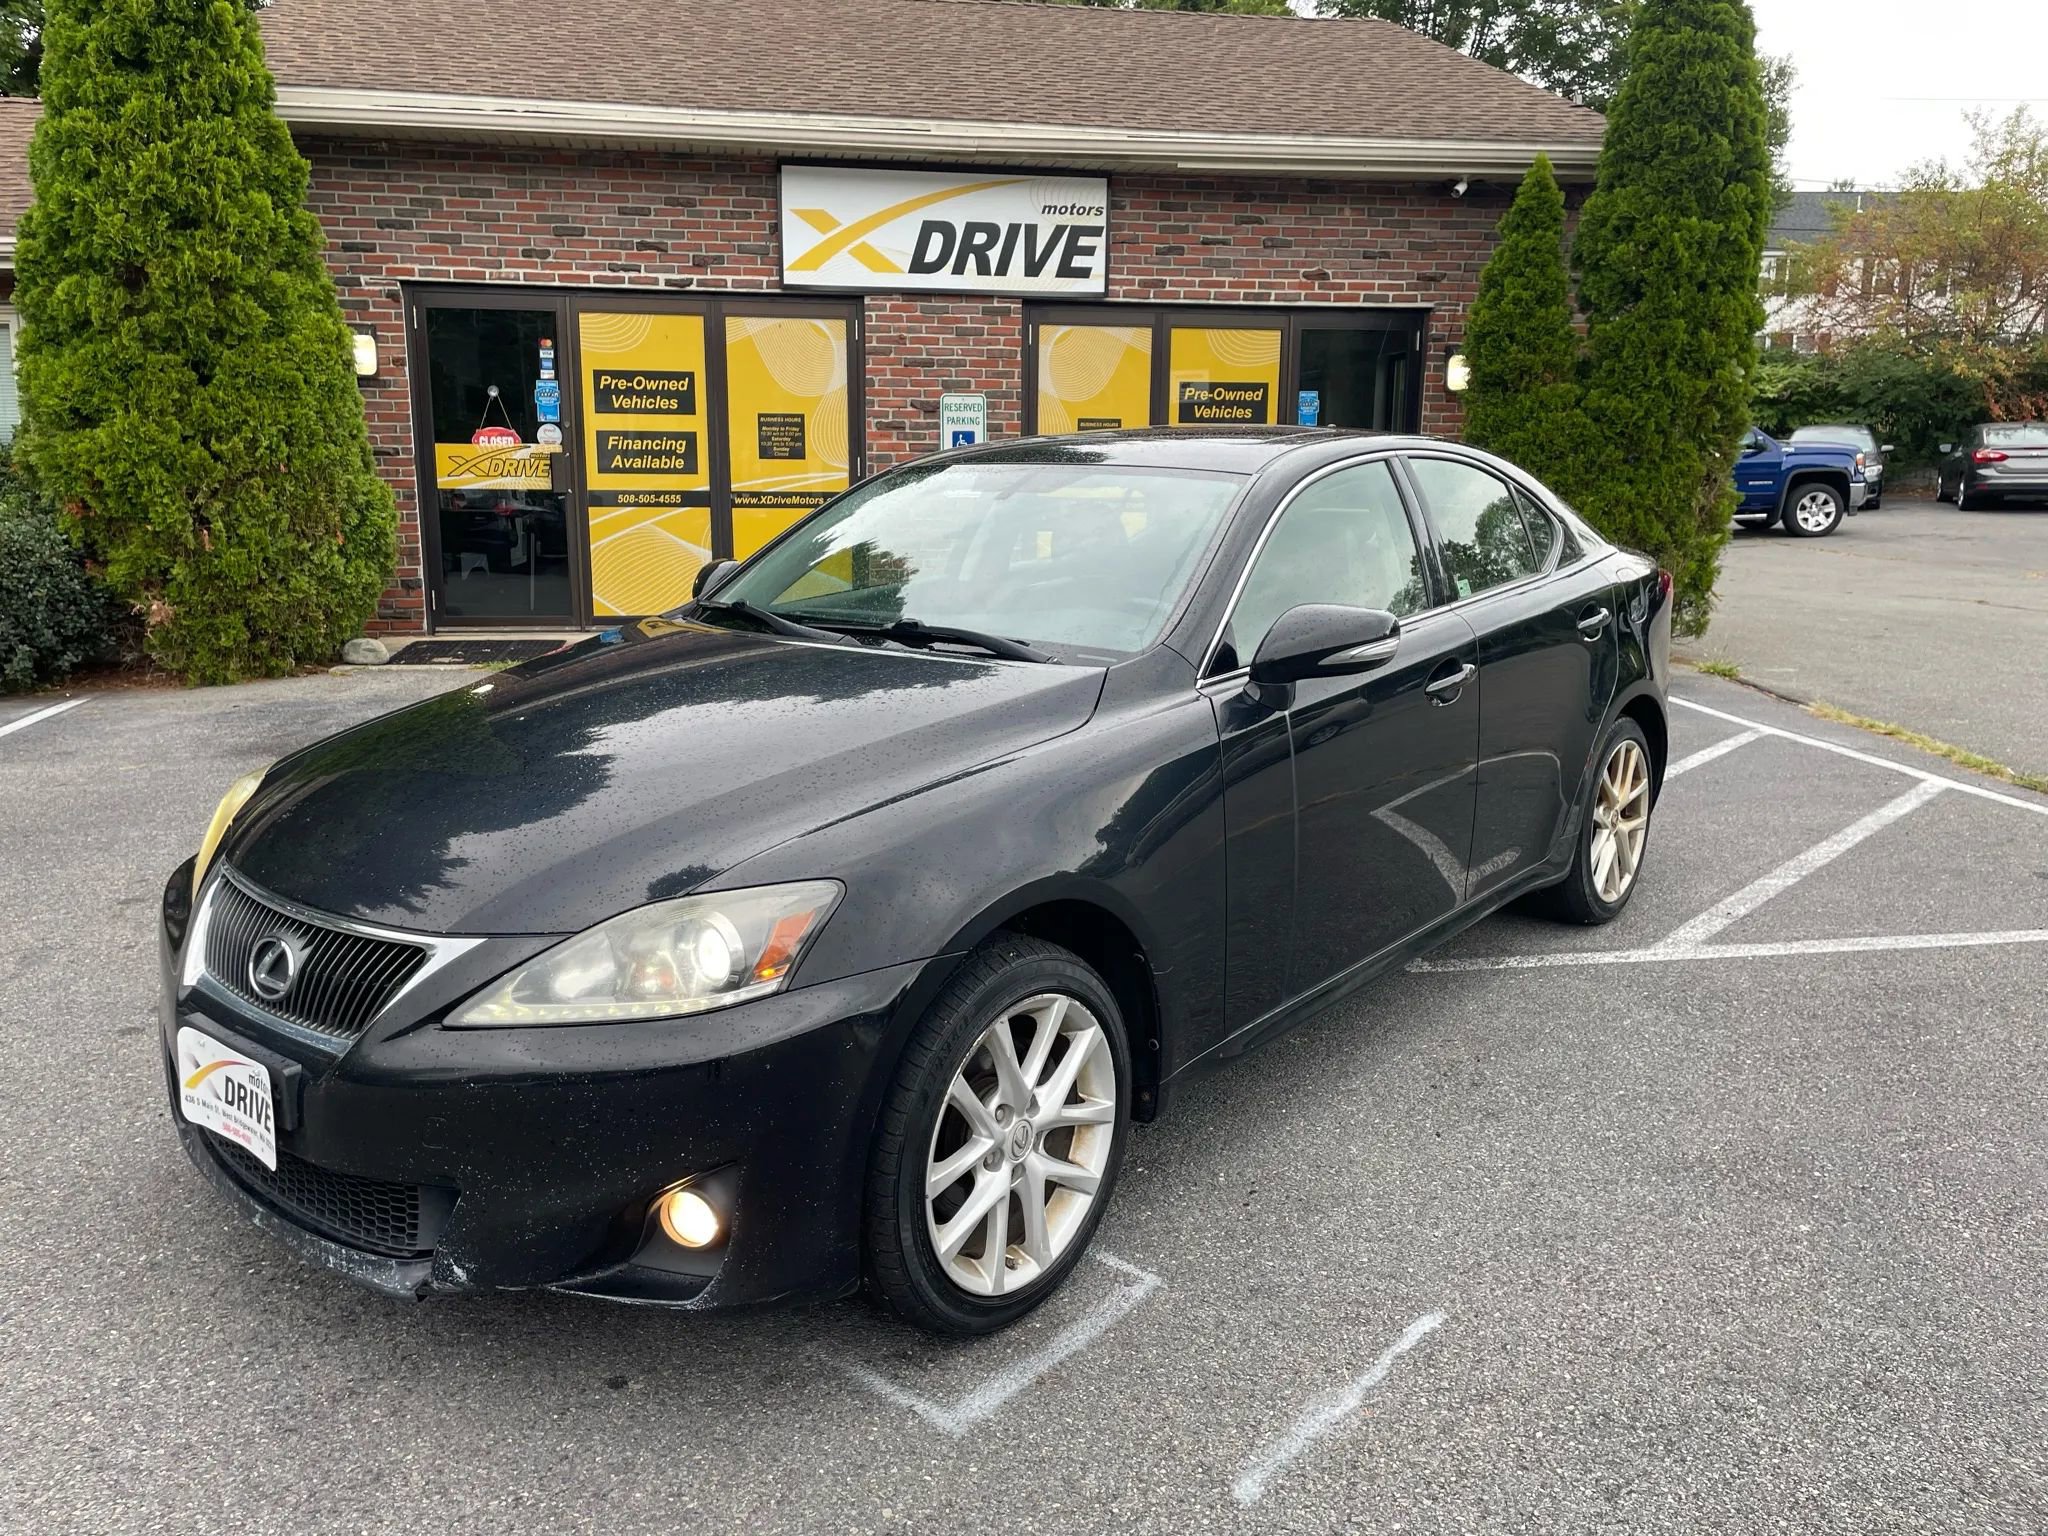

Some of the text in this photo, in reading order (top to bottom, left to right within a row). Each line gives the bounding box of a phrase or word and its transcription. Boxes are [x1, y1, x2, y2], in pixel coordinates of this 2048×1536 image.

[1041, 202, 1104, 217] motors
[908, 220, 1105, 279] DRIVE
[600, 375, 689, 391] Pre-Owned
[1184, 387, 1264, 401] Pre-Owned
[611, 394, 678, 409] Vehicles
[944, 402, 983, 412] RESERVED
[1194, 405, 1253, 419] Vehicles
[947, 417, 980, 426] PARKING
[479, 436, 515, 446] CLOSED
[607, 436, 687, 454] Financing
[611, 455, 685, 469] Available
[617, 494, 682, 504] 508-505-4555
[225, 1075, 272, 1134] DRIVE
